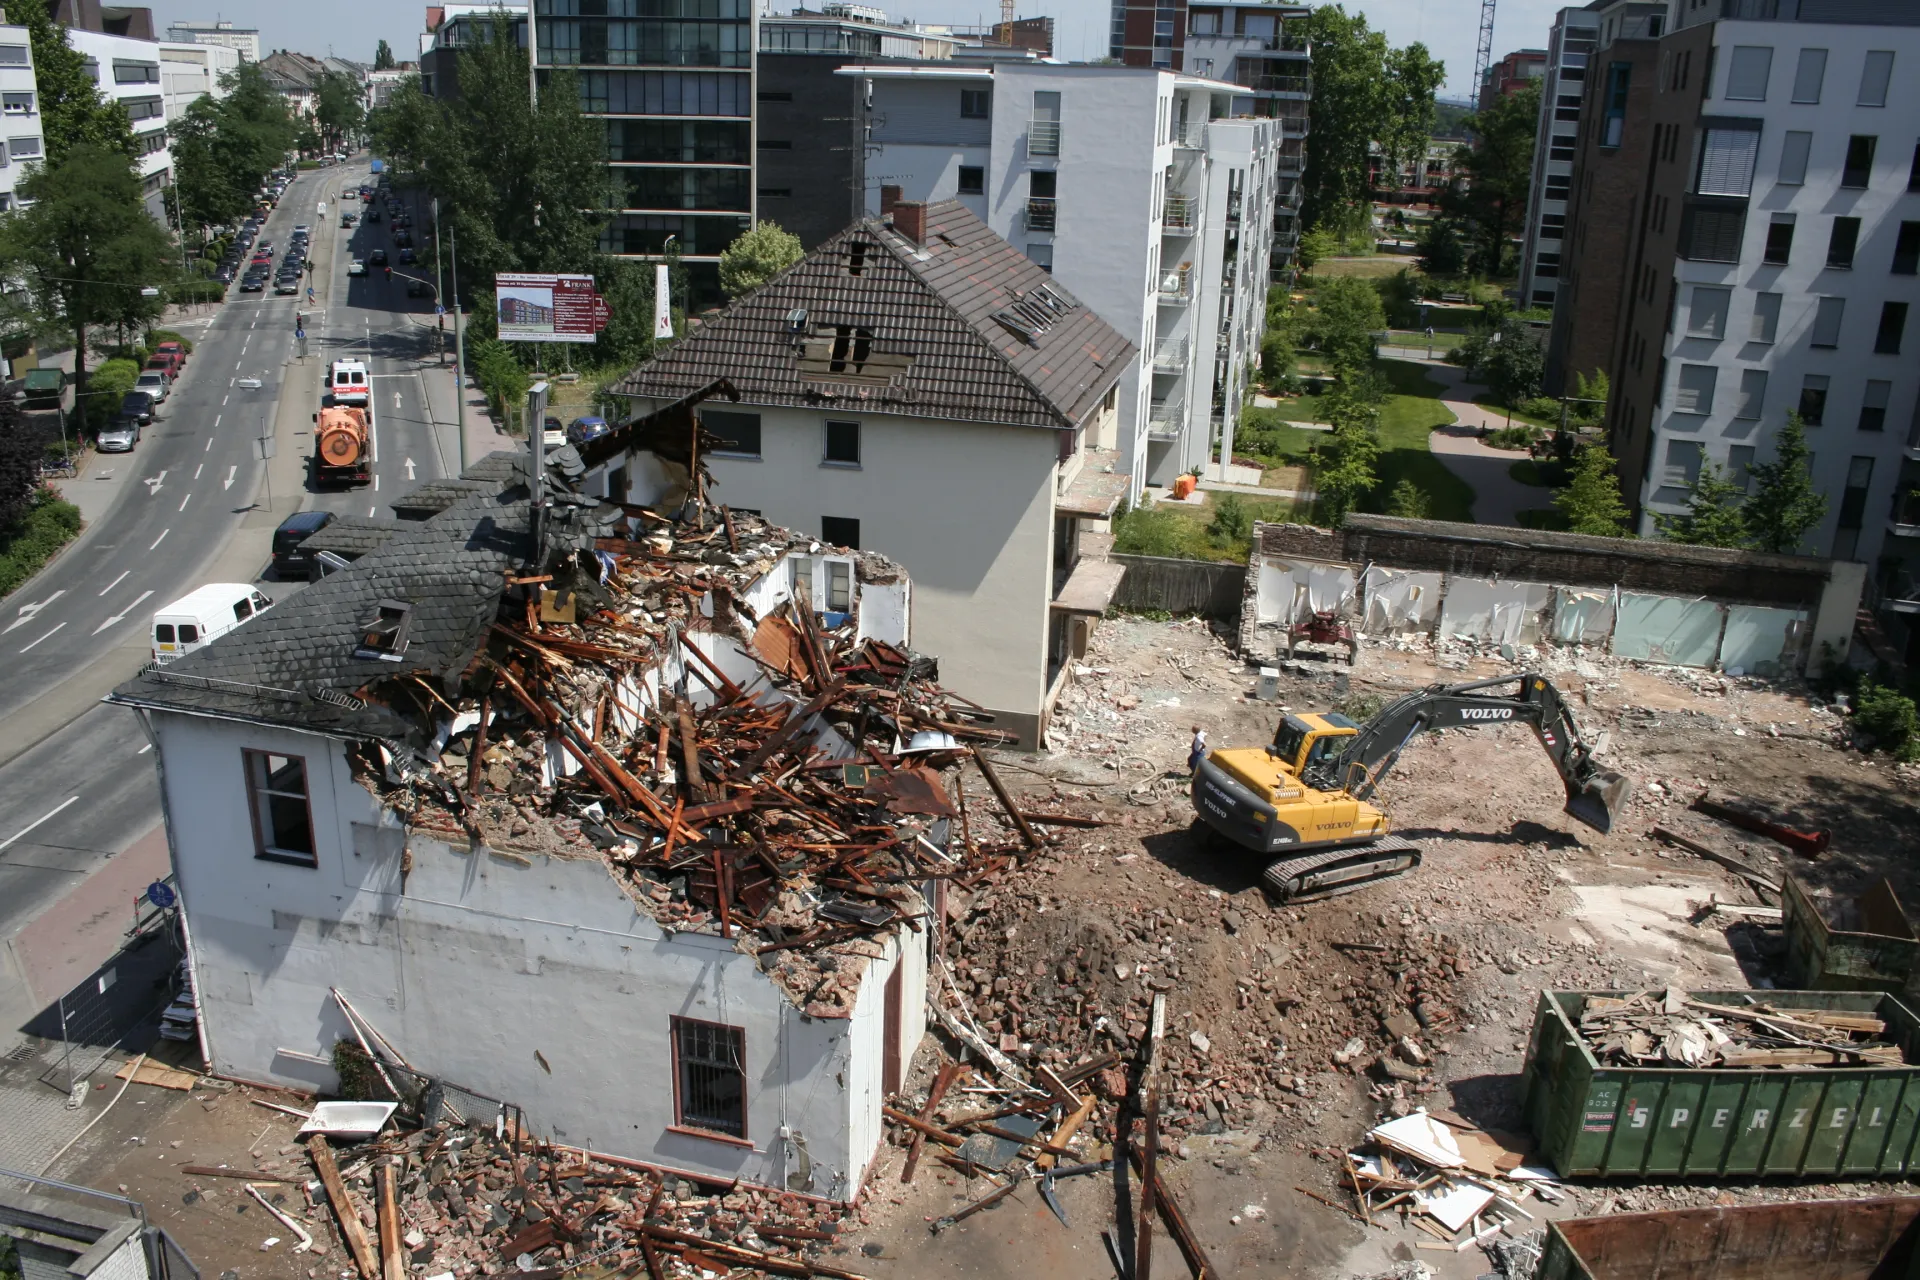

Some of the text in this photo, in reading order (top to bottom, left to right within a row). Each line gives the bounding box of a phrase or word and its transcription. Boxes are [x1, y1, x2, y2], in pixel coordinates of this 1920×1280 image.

[1460, 708, 1513, 719] VOLVO
[1204, 797, 1227, 819] VOLVO
[1316, 821, 1352, 831] VOLVO
[1630, 1107, 1884, 1128] SPERZEL
